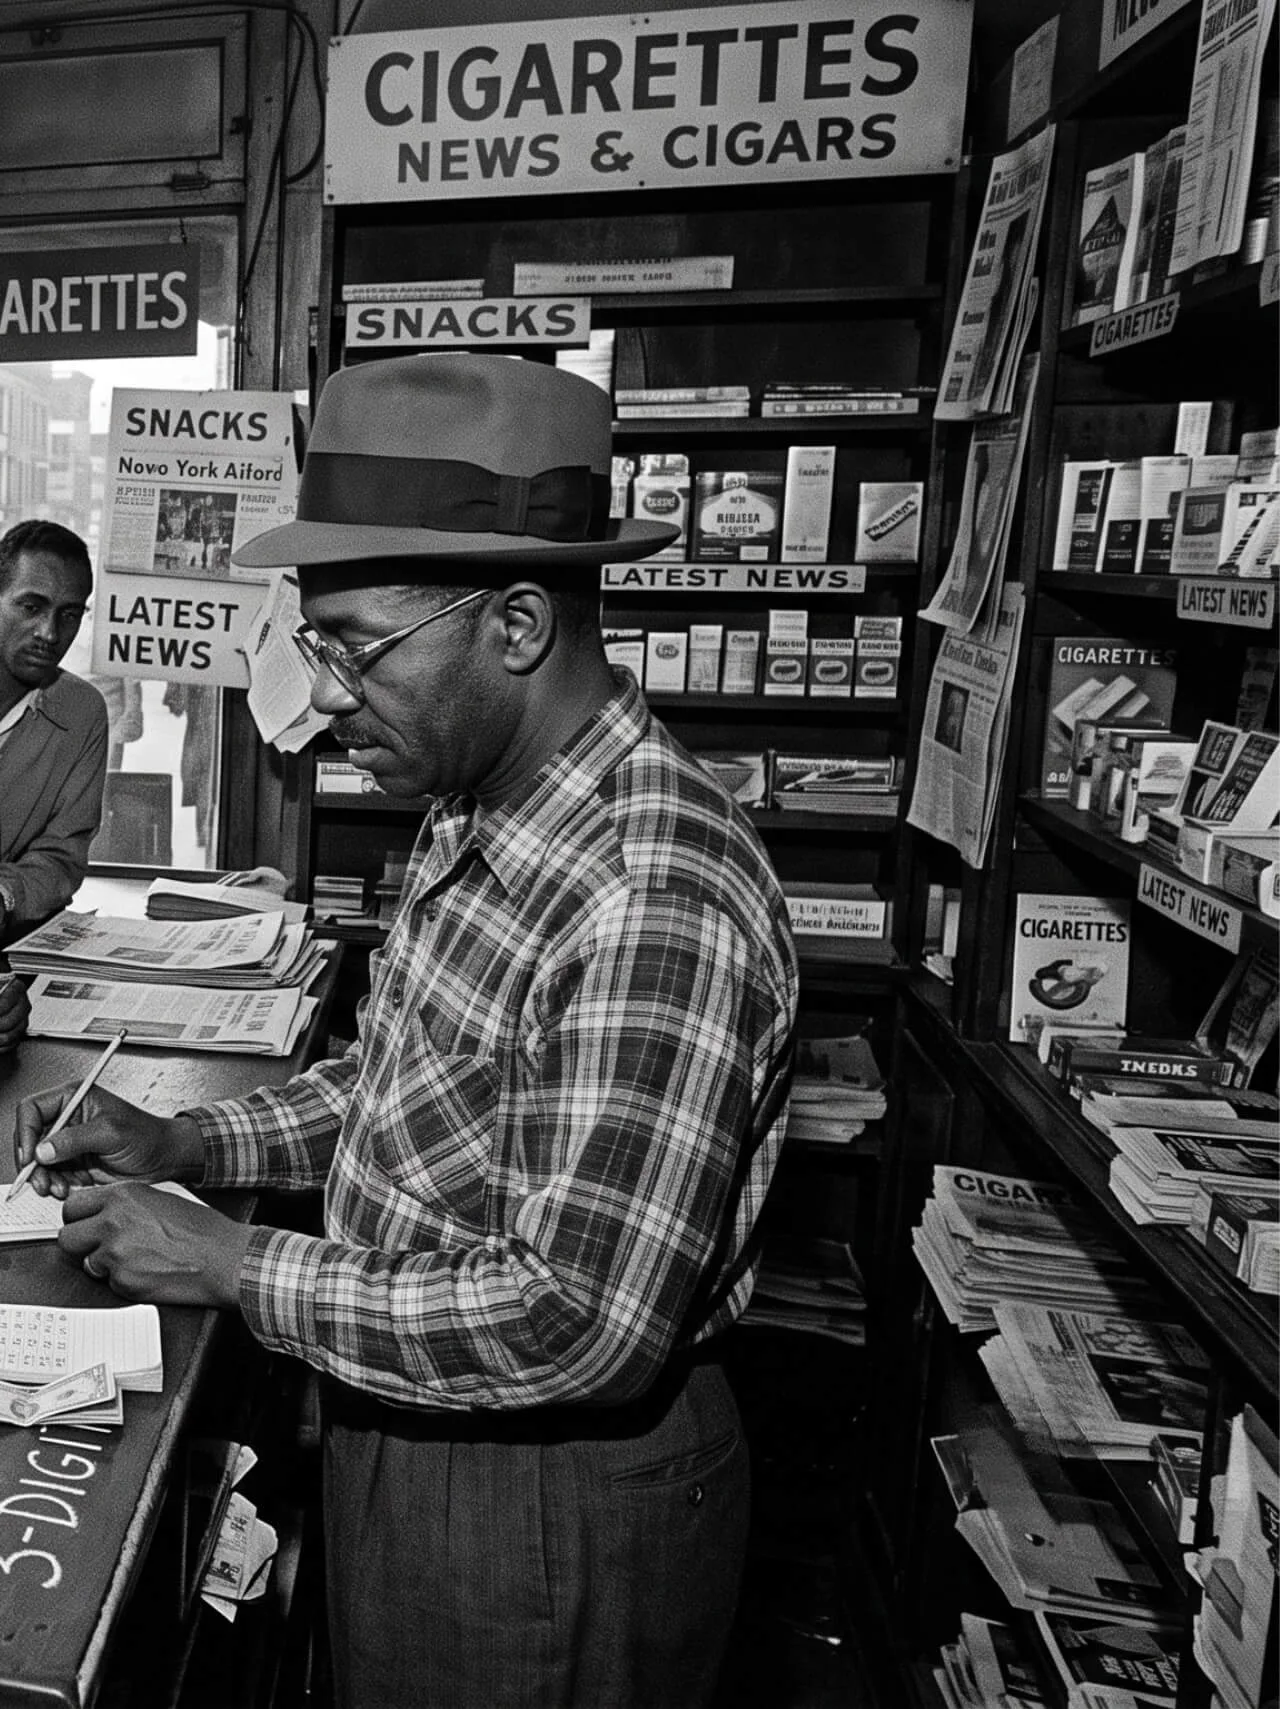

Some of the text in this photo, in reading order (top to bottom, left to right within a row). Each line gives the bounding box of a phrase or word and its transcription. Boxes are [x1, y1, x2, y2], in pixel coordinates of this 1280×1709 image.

[364, 14, 920, 127] CIGARETTES
[397, 113, 897, 184] NEWS & CIGARS
[356, 303, 577, 341] SNACKS
[1094, 300, 1175, 349] CIGARETTES
[126, 407, 268, 442] SNACKS
[176, 460, 219, 479] York
[604, 567, 849, 589] LATEST NEWS
[108, 593, 240, 633] LATEST
[1182, 584, 1268, 618] LATEST NEWS
[108, 633, 213, 670] NEWS
[1142, 870, 1230, 937] LATEST NEWS
[1020, 918, 1128, 943] CIGARETTES
